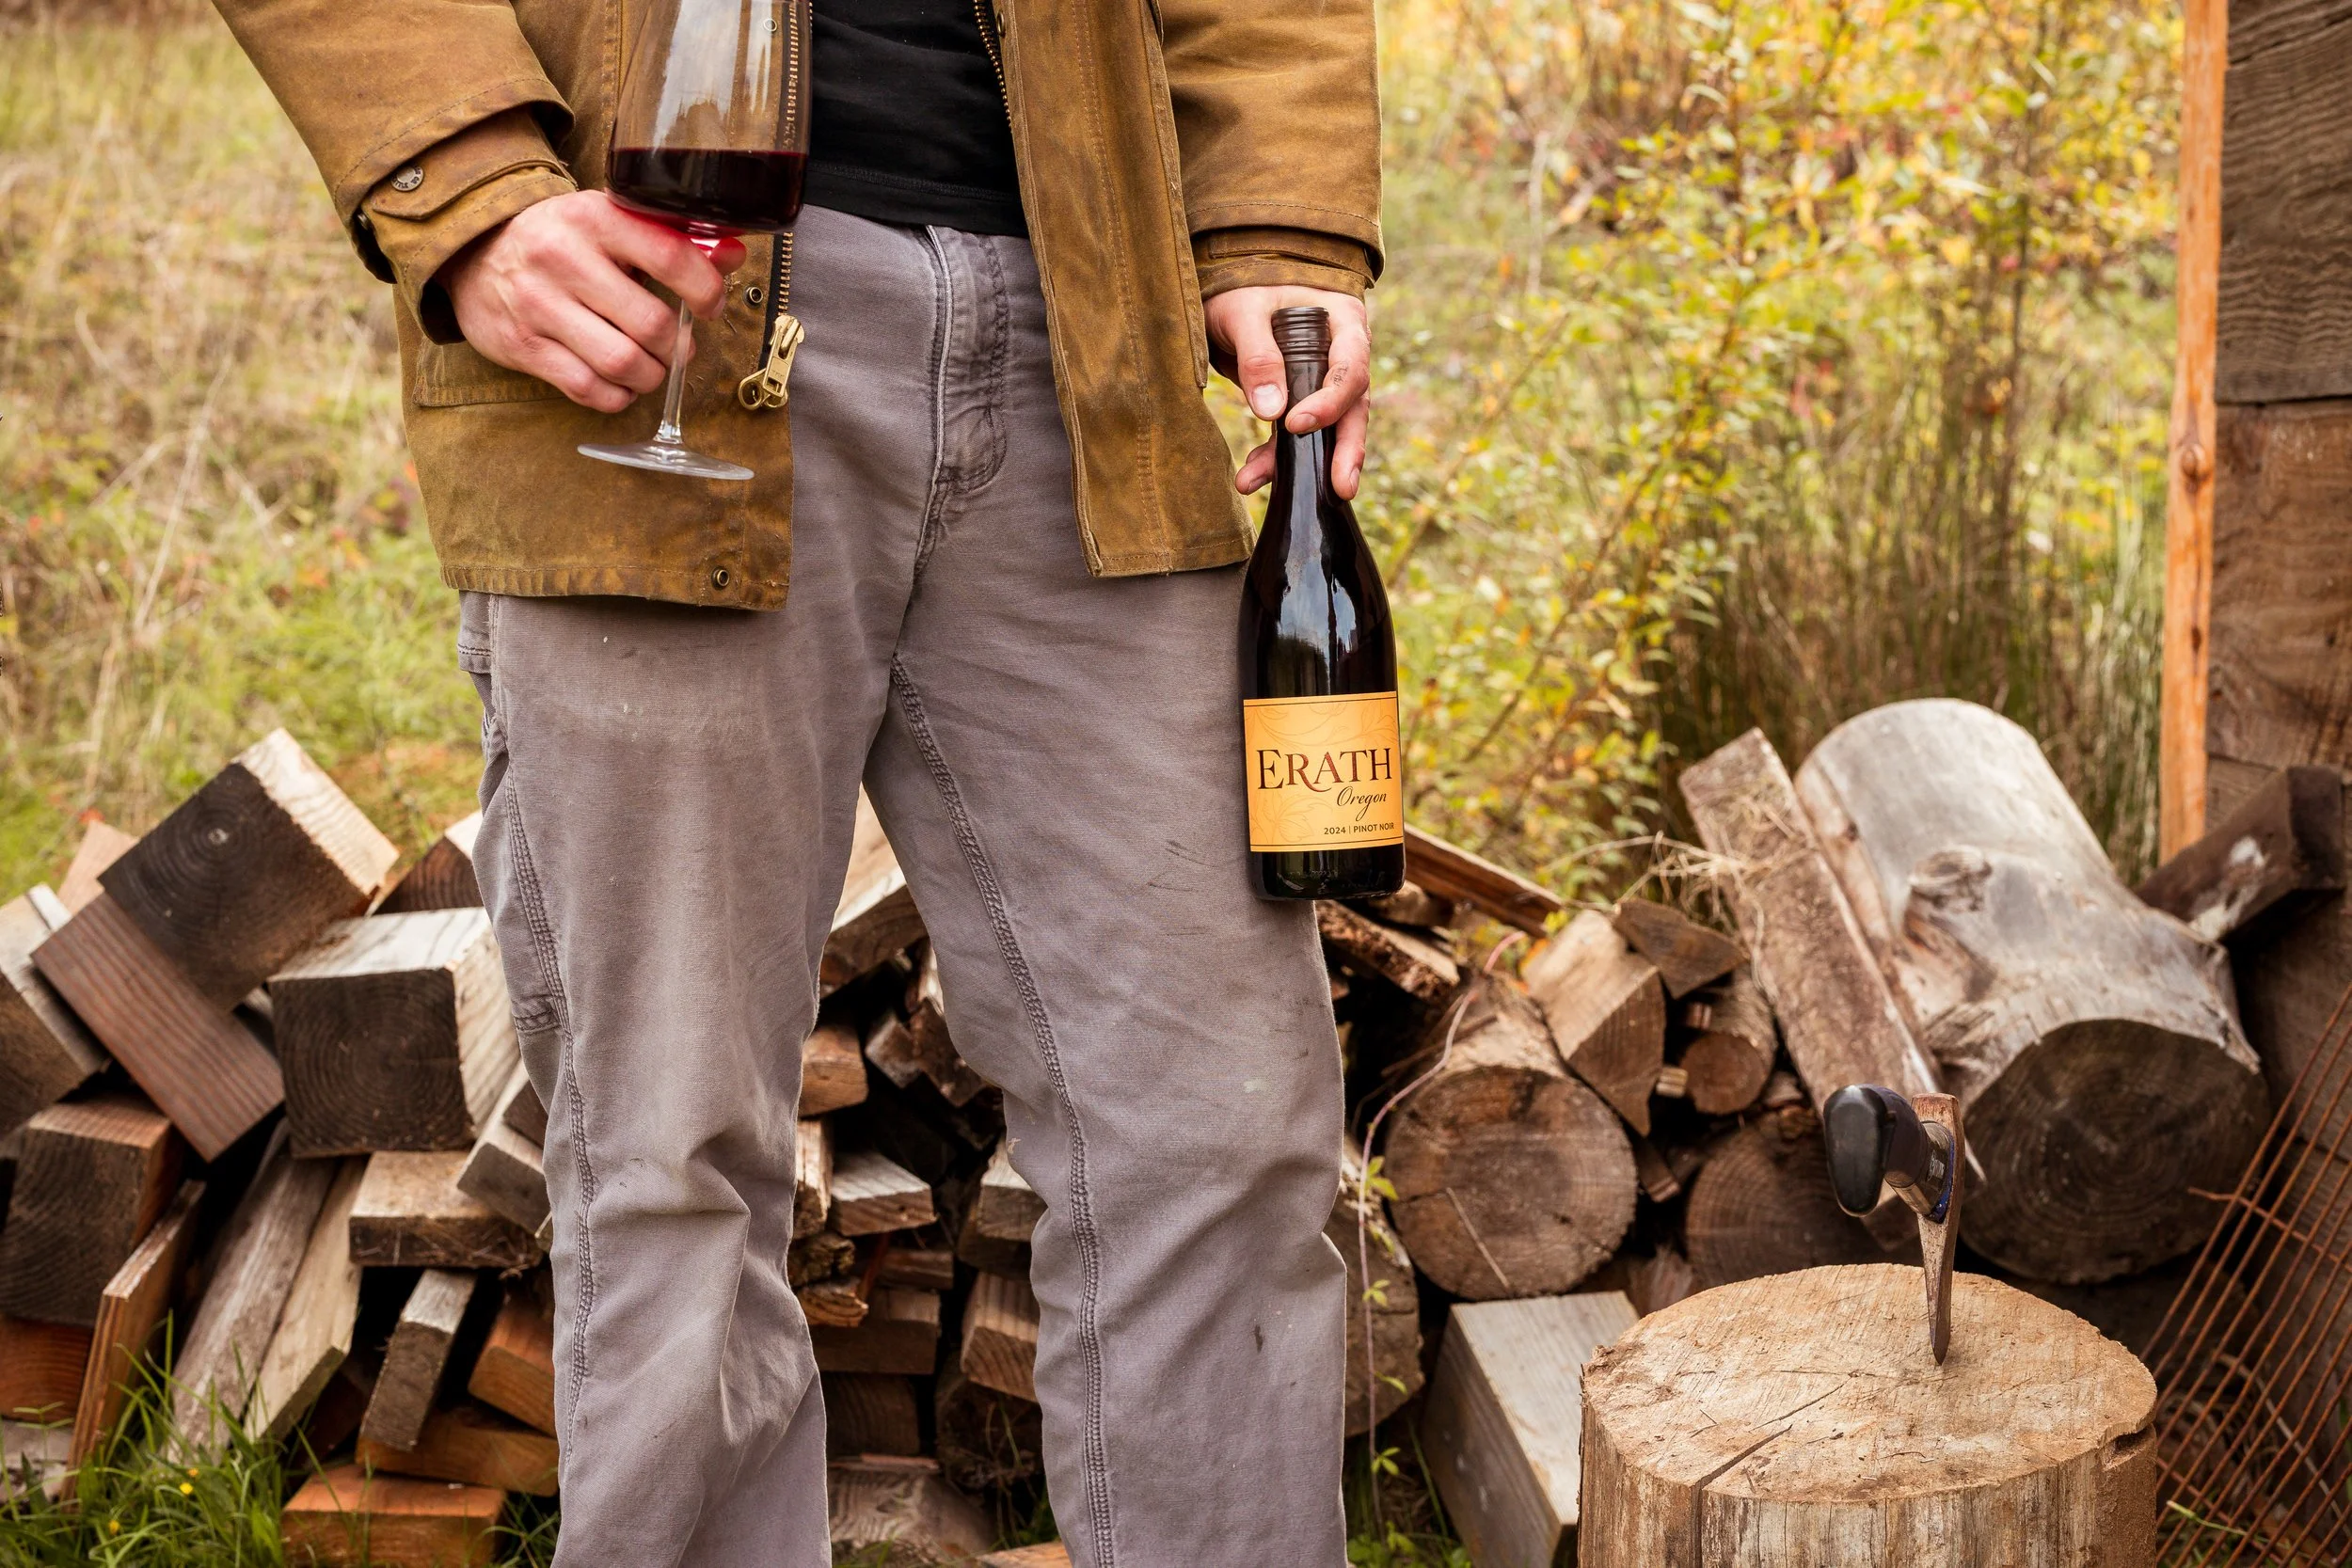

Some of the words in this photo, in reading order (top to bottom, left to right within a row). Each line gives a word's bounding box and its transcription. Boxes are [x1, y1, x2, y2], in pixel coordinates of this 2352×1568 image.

[1256, 747, 1392, 792] ERATH
[1336, 785, 1387, 822] Oregon
[1324, 826, 1346, 835] 2024
[1353, 823, 1378, 833] PINOT
[1379, 821, 1395, 832] NOIR
